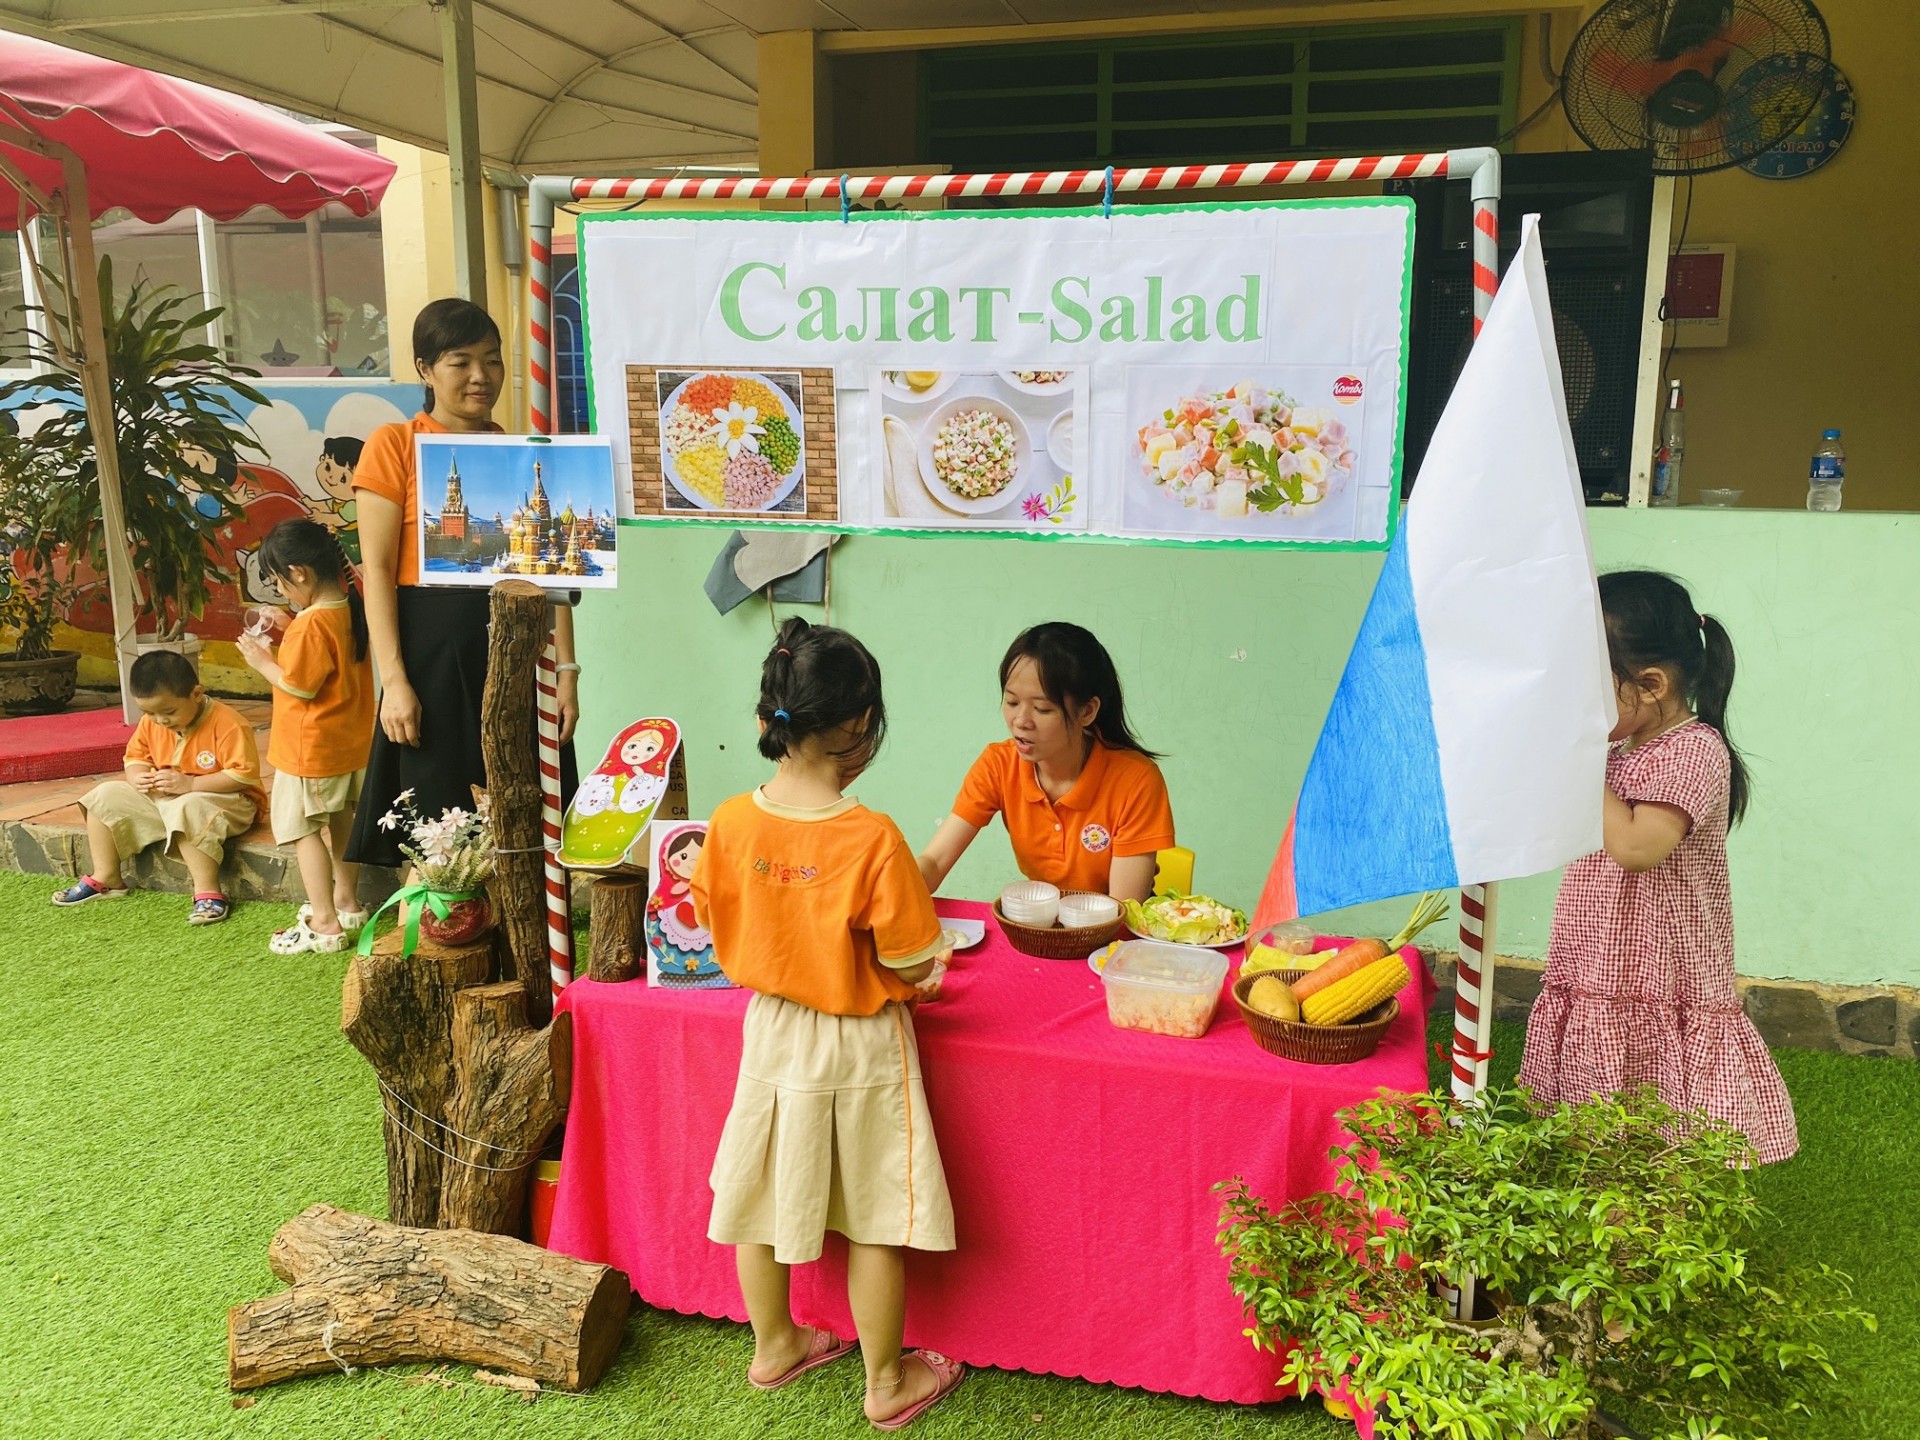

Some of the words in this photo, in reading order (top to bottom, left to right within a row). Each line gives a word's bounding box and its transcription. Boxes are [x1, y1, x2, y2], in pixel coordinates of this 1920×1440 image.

[670, 783, 684, 792] US
[671, 806, 687, 816] CA
[753, 857, 770, 875] Bé
